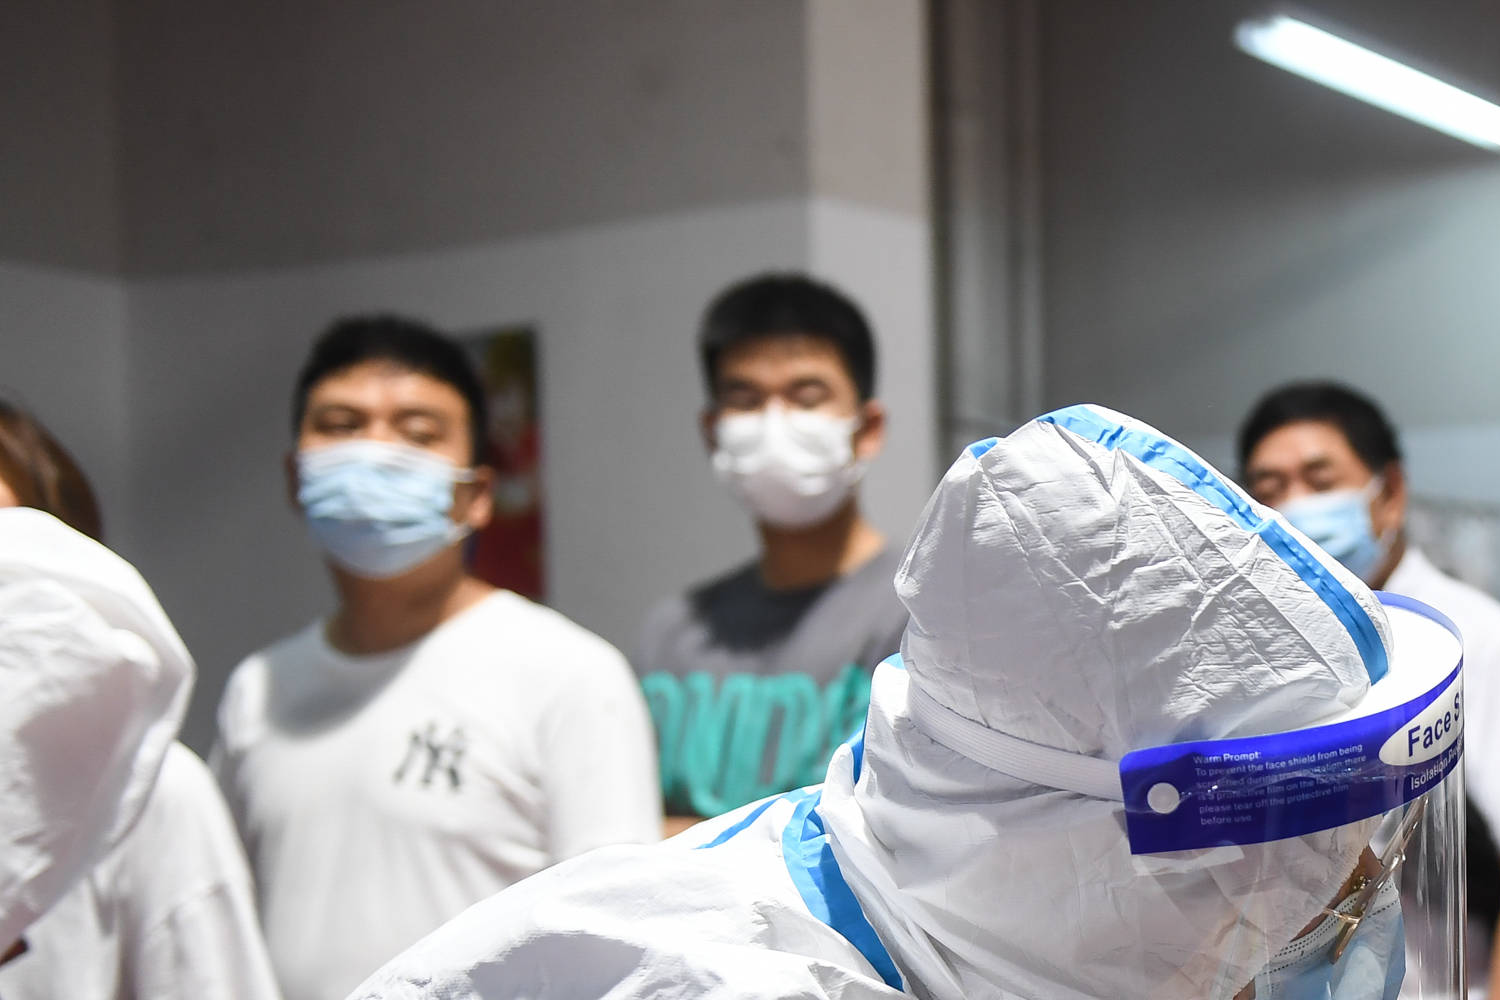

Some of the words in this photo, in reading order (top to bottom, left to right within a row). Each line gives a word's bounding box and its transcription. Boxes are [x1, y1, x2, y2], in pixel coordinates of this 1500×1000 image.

[1408, 711, 1451, 757] Face
[1193, 755, 1222, 764] Warm
[1223, 751, 1262, 762] Prompt:
[1195, 767, 1208, 776] To
[1247, 763, 1264, 773] the
[1265, 760, 1287, 769] face
[1288, 753, 1316, 766] shield
[1317, 749, 1338, 761] from
[1338, 744, 1363, 757] being
[1411, 757, 1448, 790] Isolation
[1200, 804, 1231, 815] please
[1200, 815, 1232, 826] before
